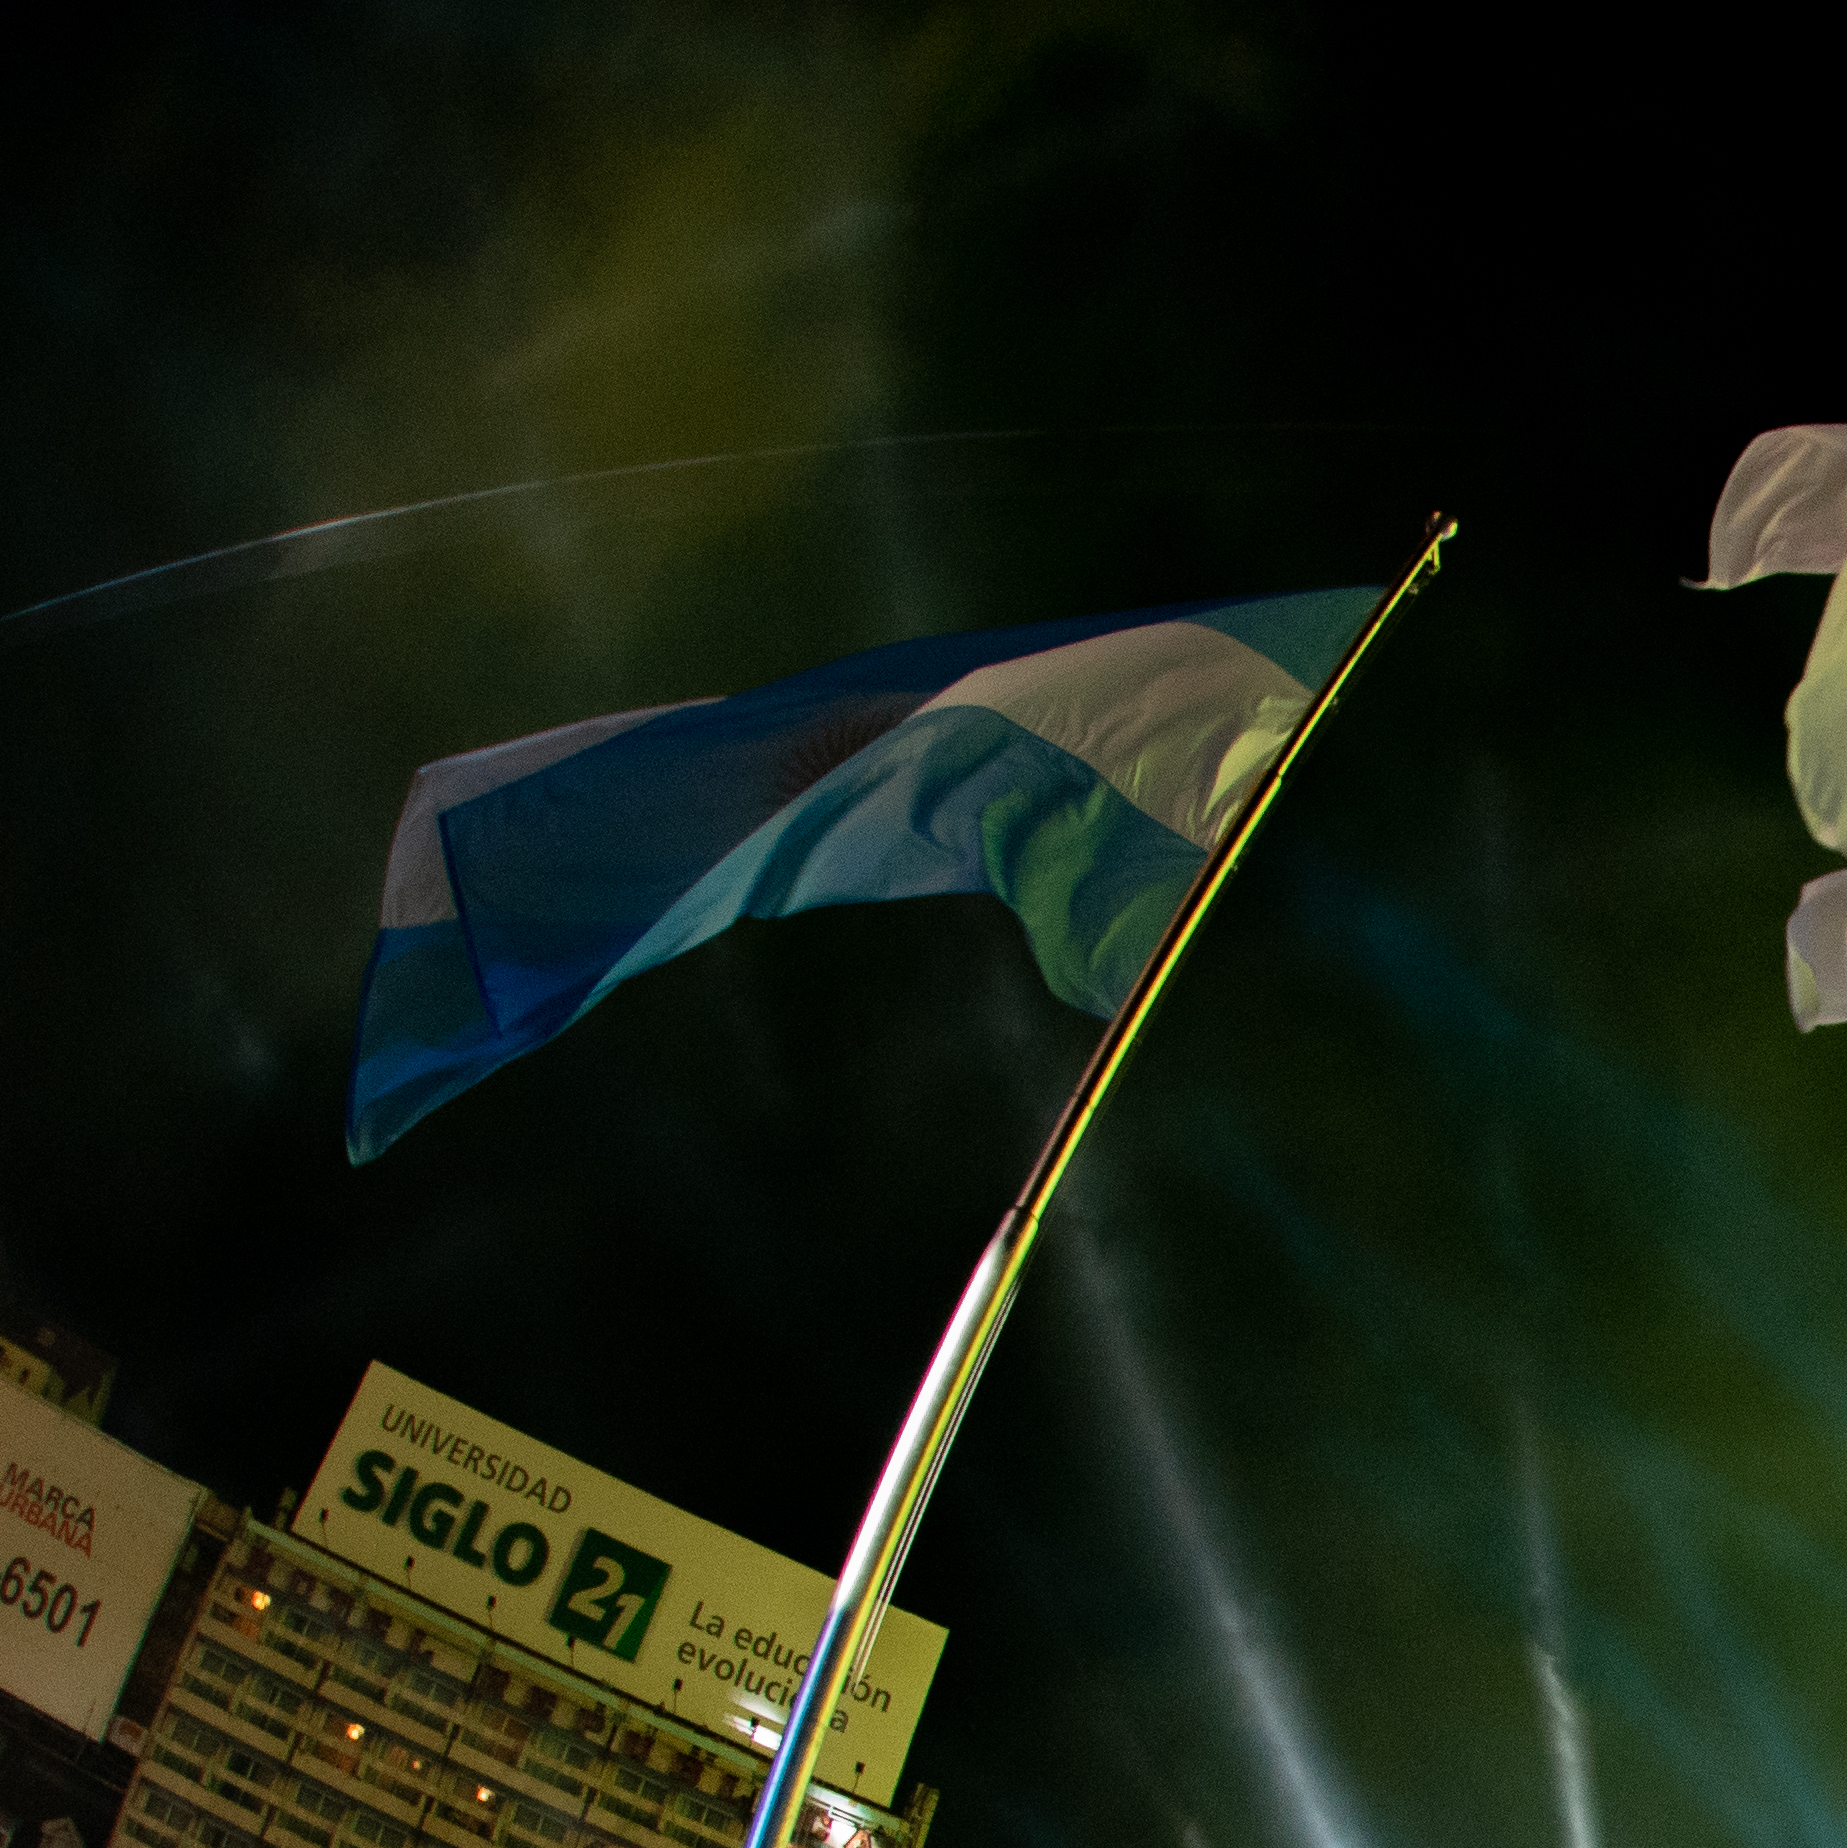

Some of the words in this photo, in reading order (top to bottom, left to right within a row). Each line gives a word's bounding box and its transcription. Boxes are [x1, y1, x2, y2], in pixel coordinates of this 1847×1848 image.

[3, 1462, 96, 1531] MARCA
[380, 1403, 572, 1514] UNIVERSIDAD
[341, 1449, 551, 1587] SIGLO
[565, 1555, 646, 1651] 21
[677, 1638, 850, 1734] evolucia
[688, 1600, 726, 1639] La
[733, 1627, 892, 1712] edución
